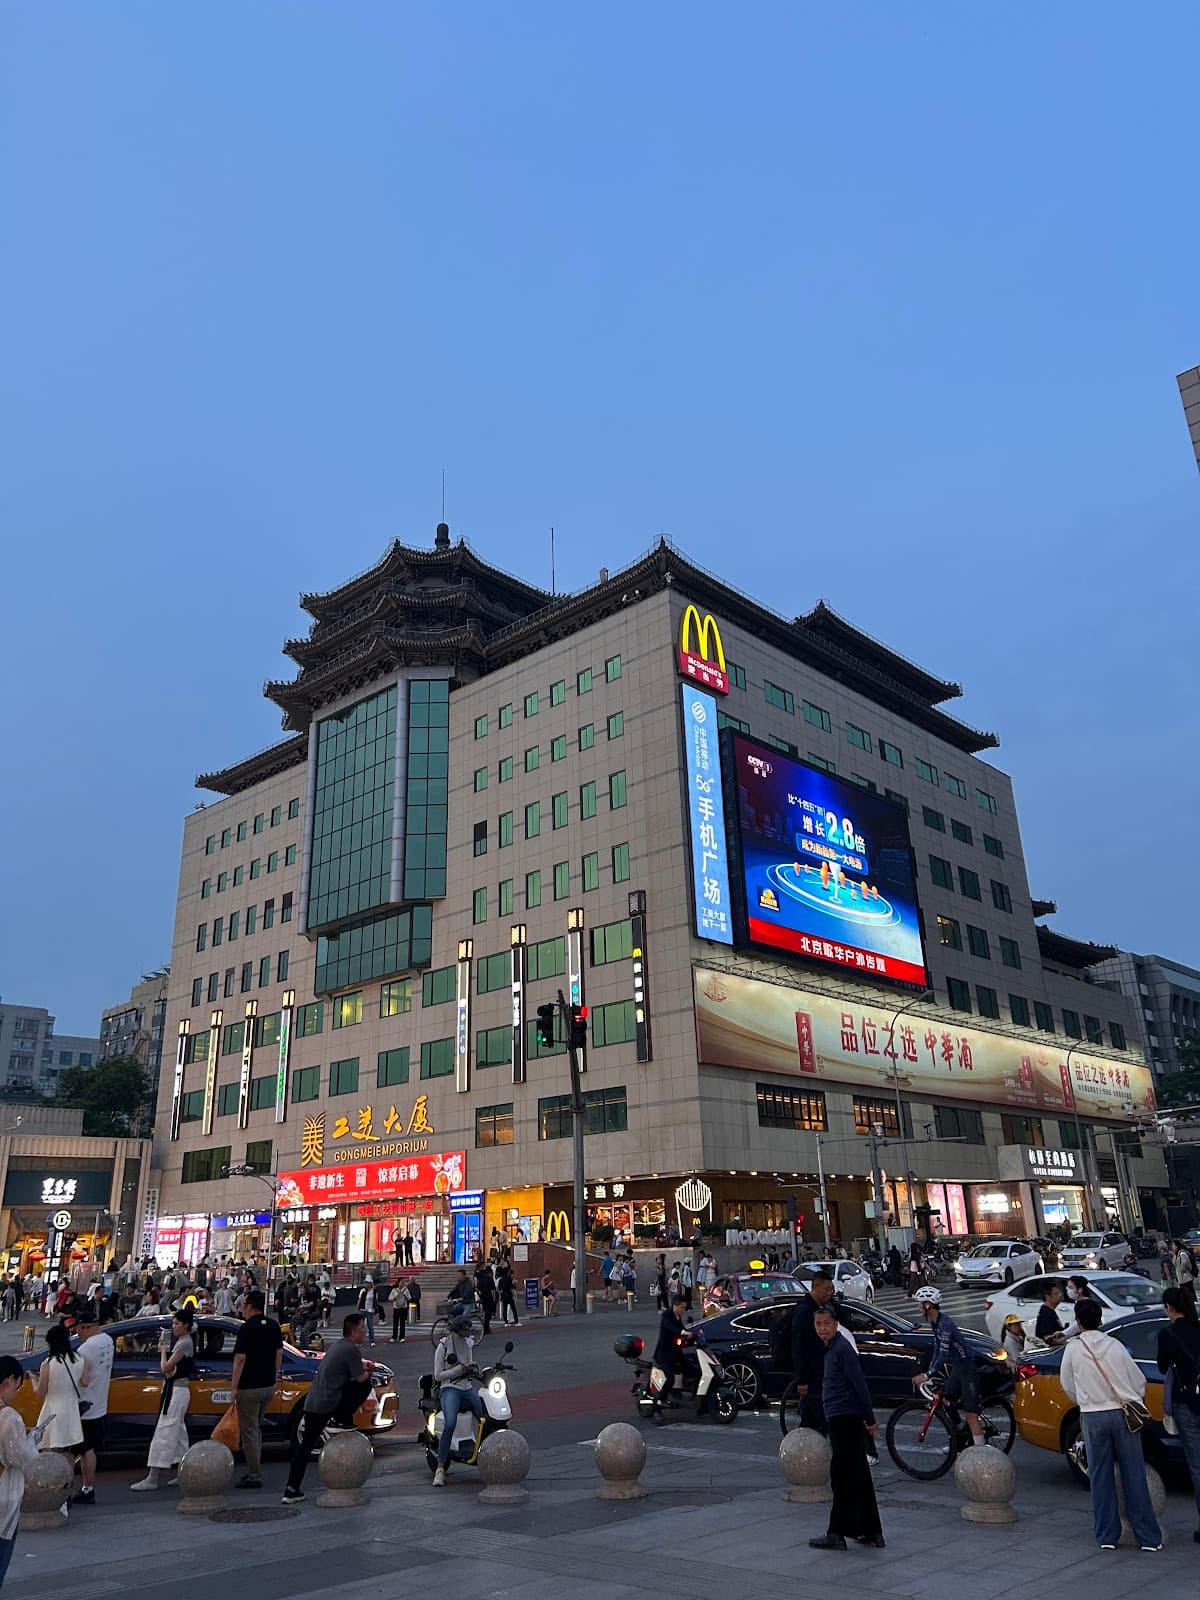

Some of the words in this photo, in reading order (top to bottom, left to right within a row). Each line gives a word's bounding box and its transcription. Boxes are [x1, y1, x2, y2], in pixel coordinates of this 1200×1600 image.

[687, 655, 722, 679] McDonald's
[698, 796, 721, 906] 手机广场
[331, 1094, 434, 1141] 工美大厦
[308, 1172, 345, 1191] 非遗新生
[377, 1163, 420, 1184] 惊喜启幕
